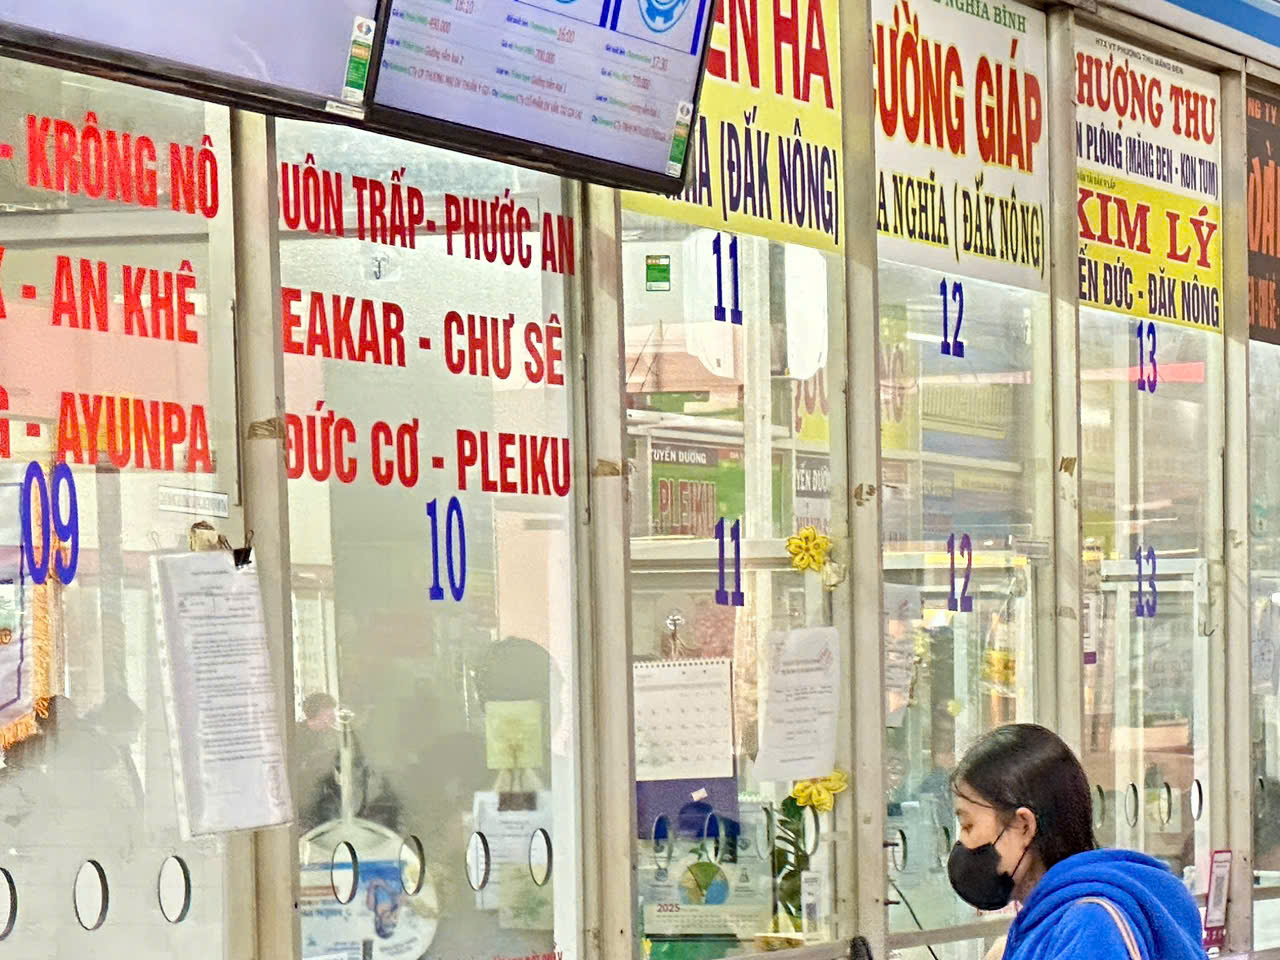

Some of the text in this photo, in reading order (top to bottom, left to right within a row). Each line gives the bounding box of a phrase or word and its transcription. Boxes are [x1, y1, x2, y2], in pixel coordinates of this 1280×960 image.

[872, 1, 1041, 173] ƯỜNG GIÁP
[1076, 52, 1216, 144] HƯỢNG THU
[1265, 103, 1277, 125] TY
[26, 111, 219, 219] KRÔNG NÔ
[1087, 122, 1123, 170] PLÔNG
[1156, 145, 1173, 183] ĐEN
[1180, 153, 1197, 191] KON
[1199, 158, 1218, 201] TUM)
[444, 188, 532, 267] PHƯỚC
[541, 212, 576, 276] AN
[893, 169, 948, 246] NGHĨA
[1000, 185, 1044, 279] NÔNG)
[1077, 187, 1217, 269] KIM LÝ
[51, 255, 198, 344] AN KHÊ
[711, 232, 743, 325] 11
[939, 277, 965, 358] 12
[1103, 257, 1133, 310] ĐỨC
[1181, 274, 1219, 328] NÔNG
[281, 288, 565, 386] EAKAR CHƯ SÊ
[1136, 321, 1157, 394] 13
[57, 391, 214, 474] AYUNPA
[285, 400, 571, 498] ĐỨC CƠ PLEIKU
[22, 461, 79, 585] 09
[426, 496, 466, 601] 10
[715, 516, 744, 606] 11
[947, 533, 973, 612] 12
[1136, 545, 1156, 617] 13
[656, 903, 681, 913] 2025
